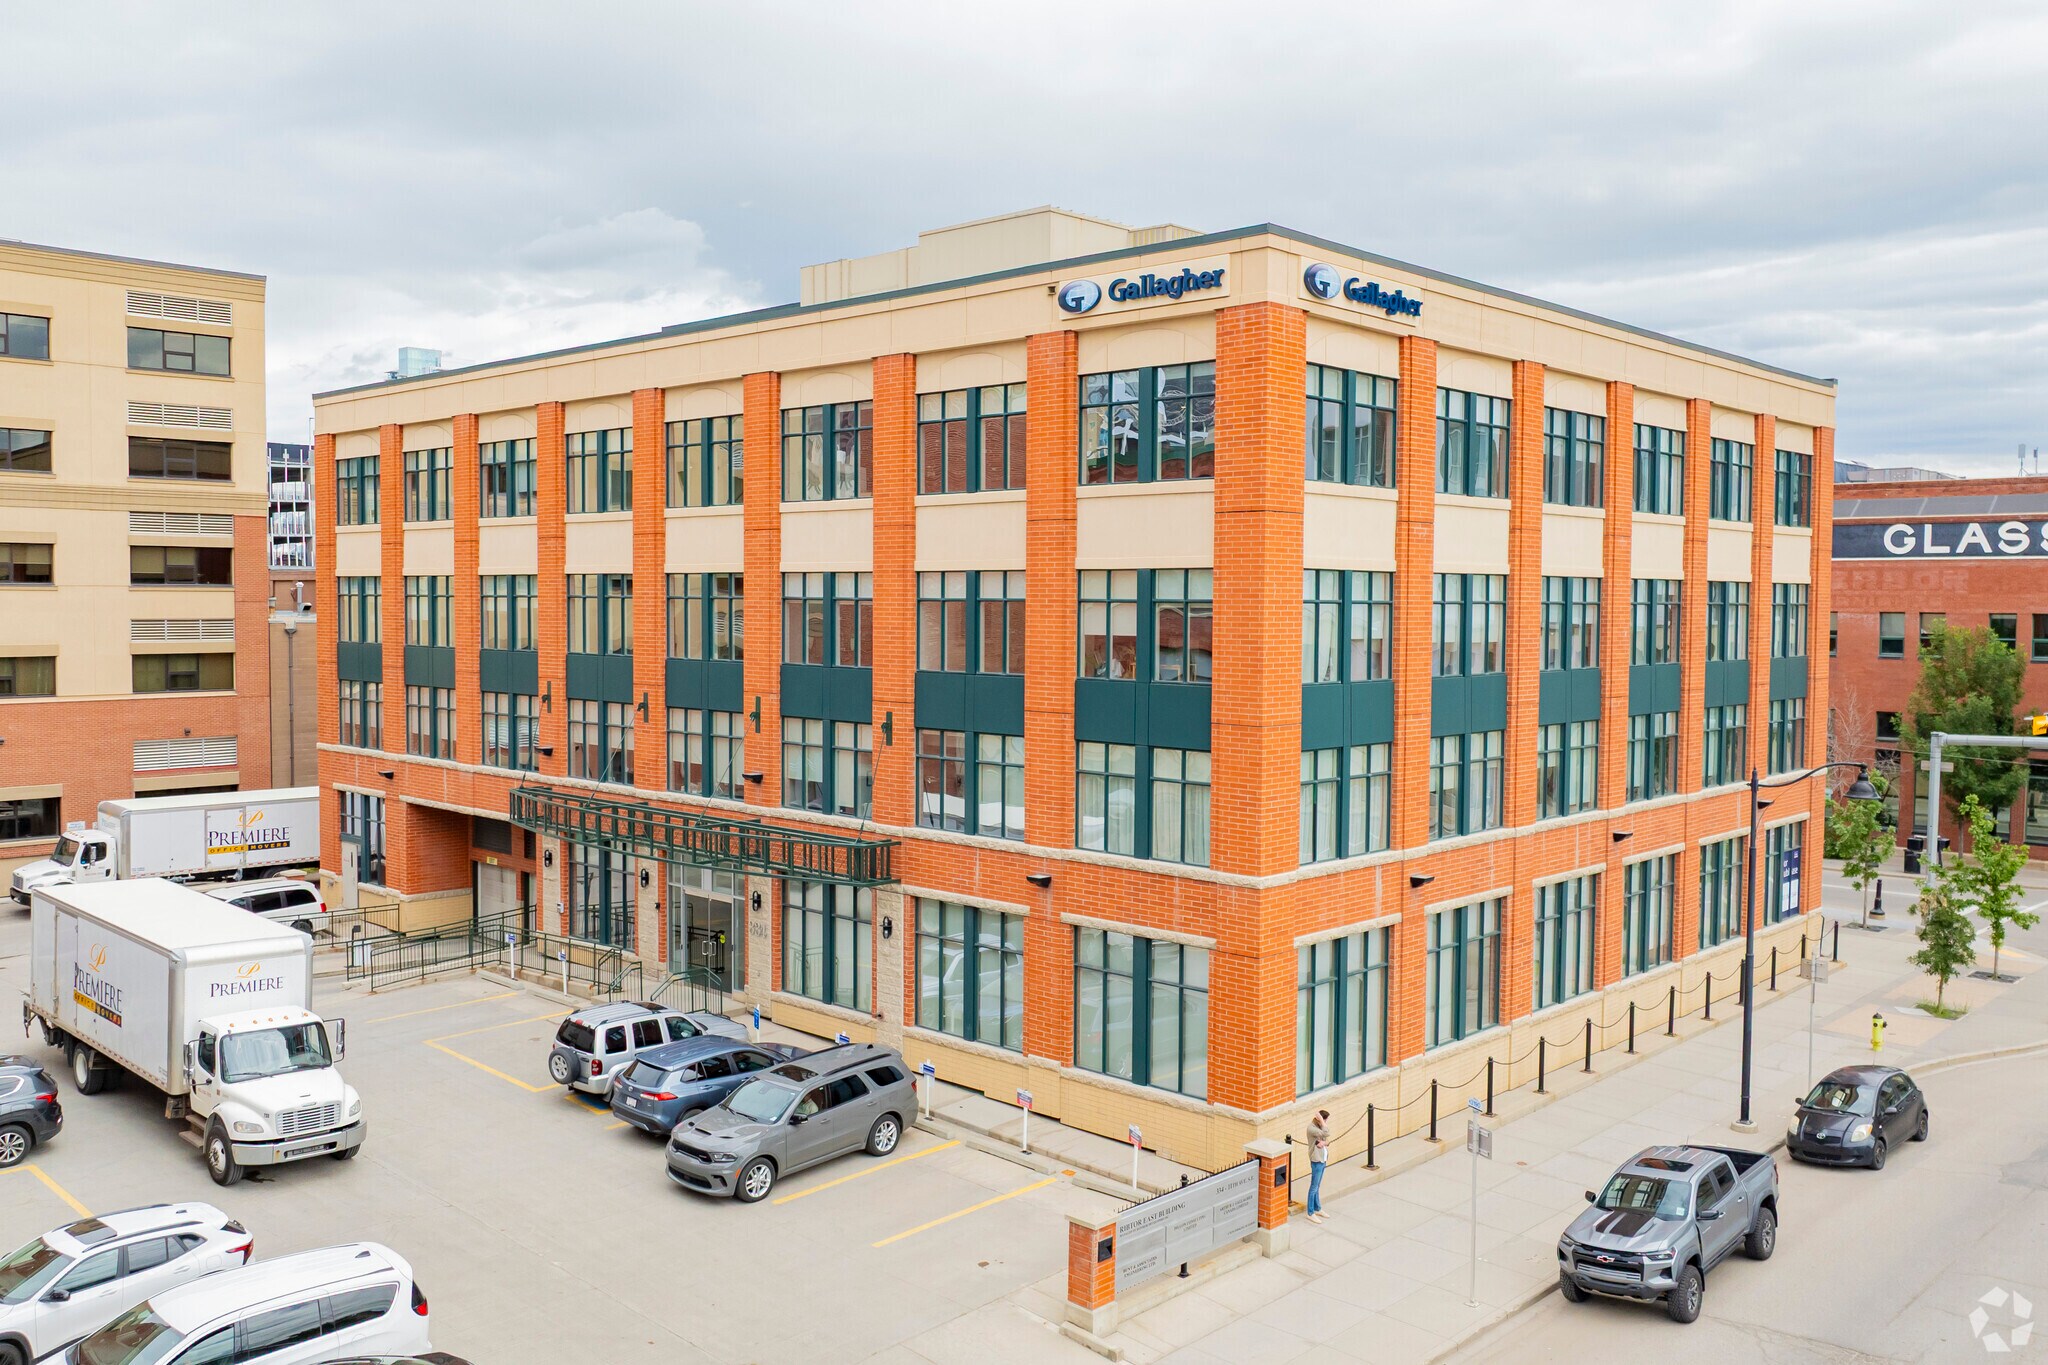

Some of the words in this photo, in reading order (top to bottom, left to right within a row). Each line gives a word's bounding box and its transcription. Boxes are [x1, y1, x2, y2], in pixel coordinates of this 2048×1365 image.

[1108, 268, 1226, 302] Gallagher
[1343, 277, 1424, 317] Gallagher
[1883, 521, 2048, 554] GLAS
[208, 827, 290, 847] PREMIERE
[209, 846, 245, 854] OFFICE
[250, 842, 288, 850] MOVERS
[74, 961, 123, 1014] PREMIERE
[210, 977, 284, 997] PREMIERE
[1158, 1202, 1186, 1218] BUILDING
